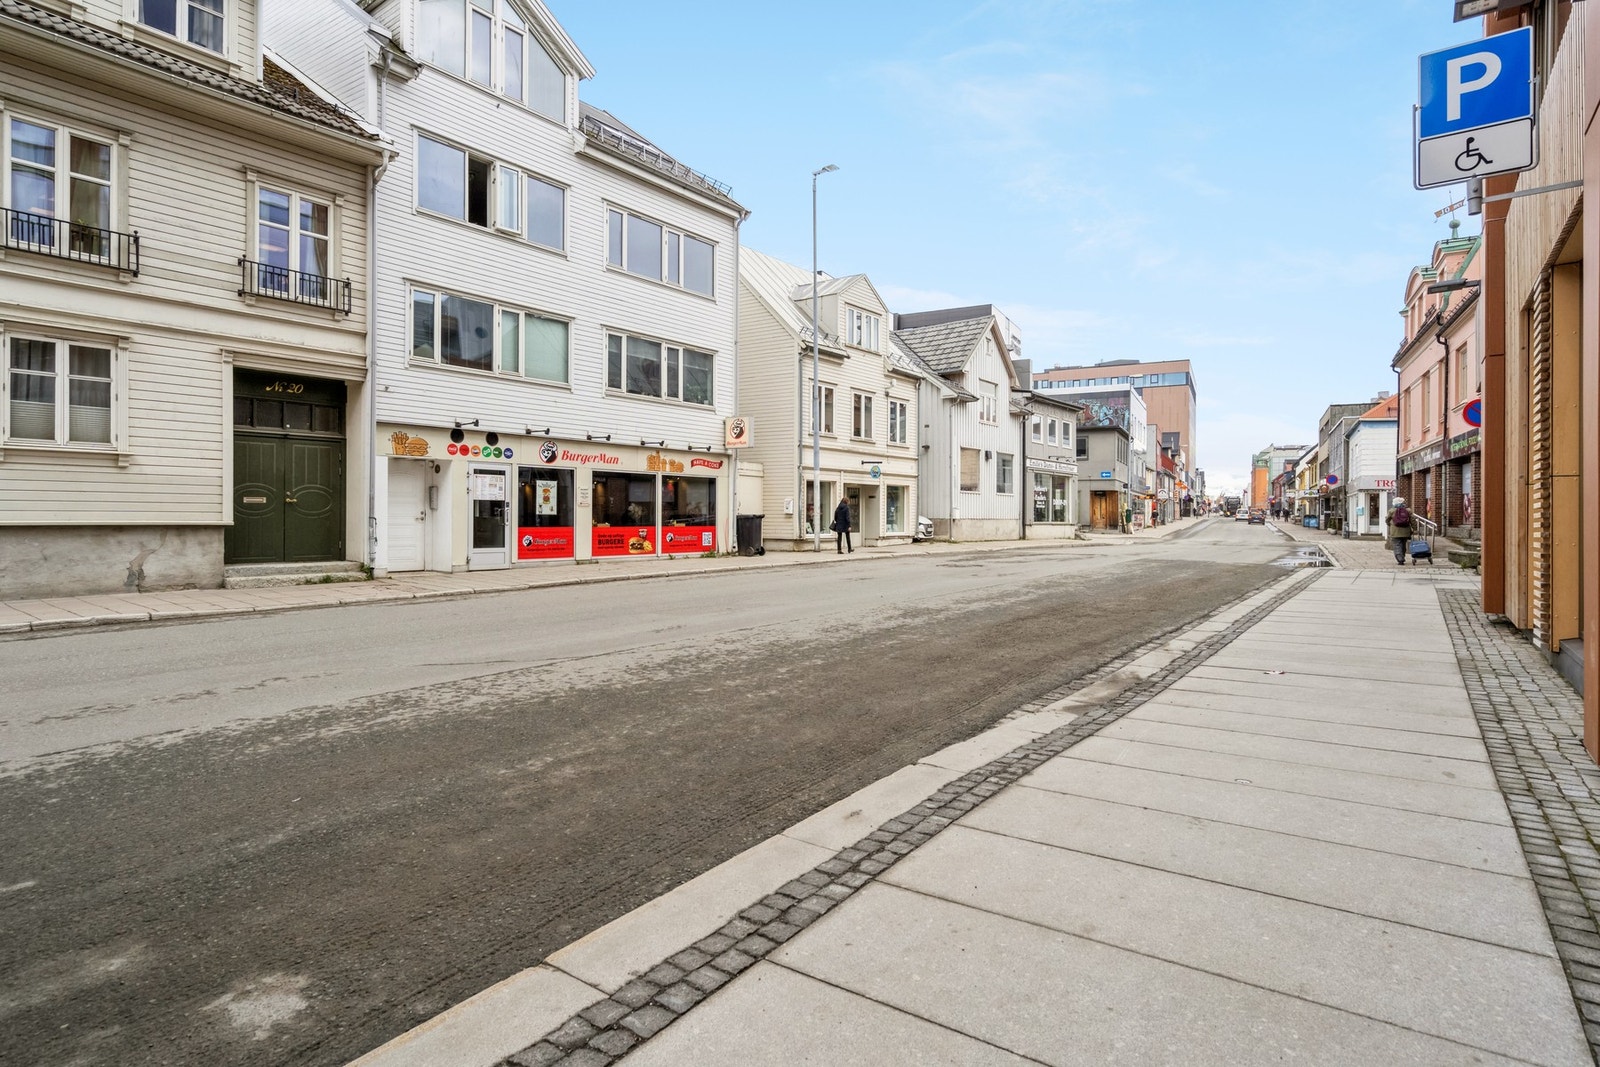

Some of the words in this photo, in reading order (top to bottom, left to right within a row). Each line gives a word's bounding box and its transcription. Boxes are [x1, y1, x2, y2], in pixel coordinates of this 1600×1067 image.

[1447, 51, 1502, 122] P
[287, 383, 304, 394] 20
[560, 450, 620, 465] BurgerMan
